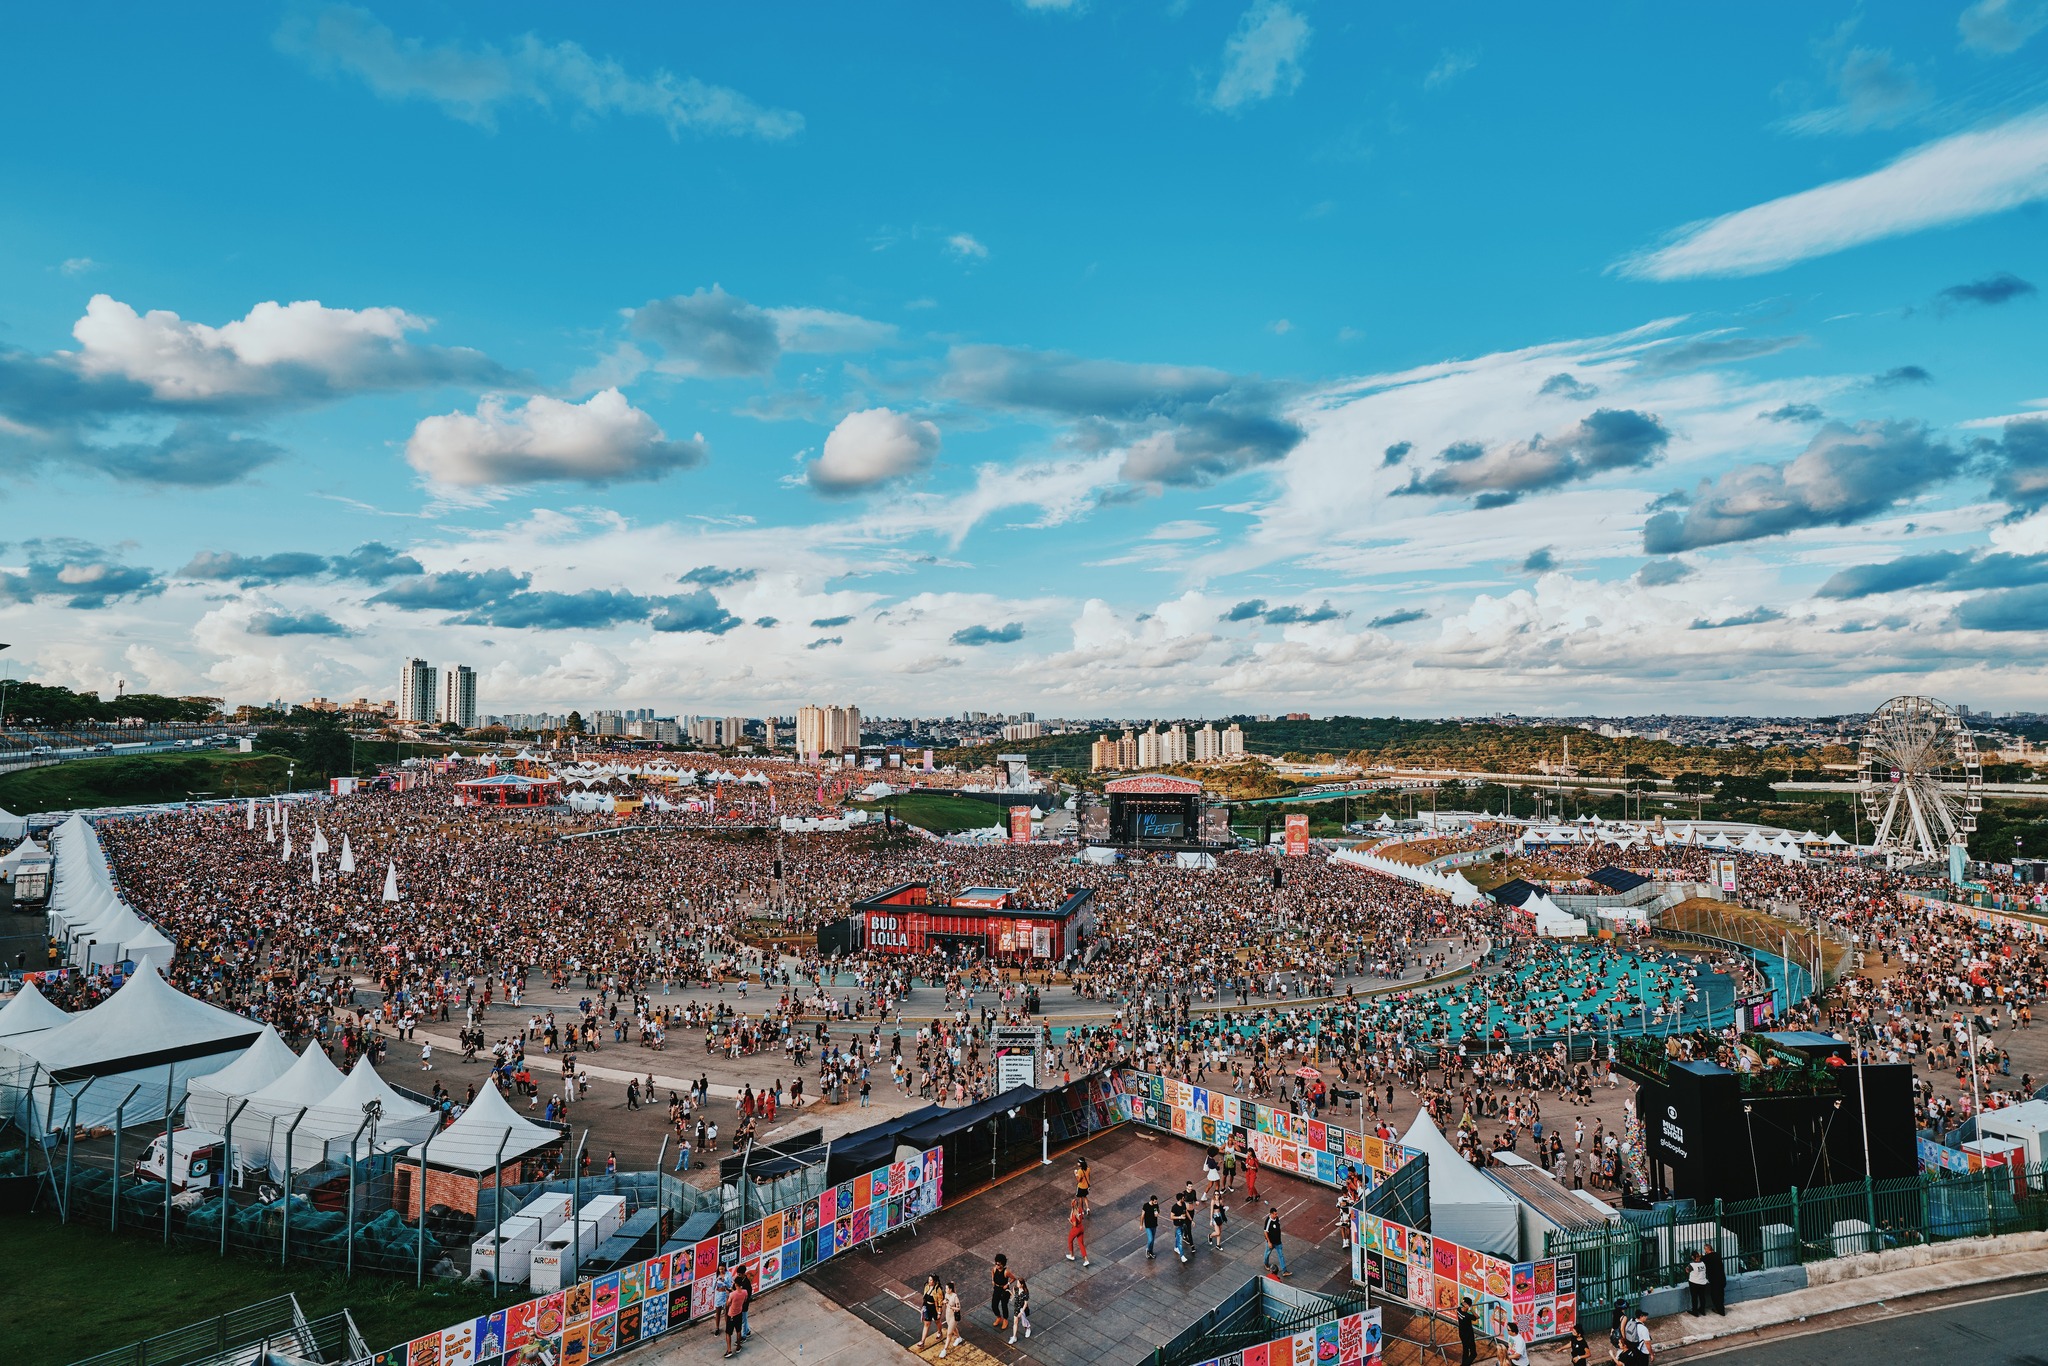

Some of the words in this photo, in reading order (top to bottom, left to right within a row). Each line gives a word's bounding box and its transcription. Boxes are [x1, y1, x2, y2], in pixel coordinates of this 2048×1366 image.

[1144, 822, 1181, 836] FEET
[1662, 1119, 1683, 1136] MULTI
[1662, 1126, 1683, 1144] SHOW
[1660, 1138, 1688, 1159] globoplay
[534, 1256, 559, 1265] AIRCAM
[674, 1296, 687, 1304] DO
